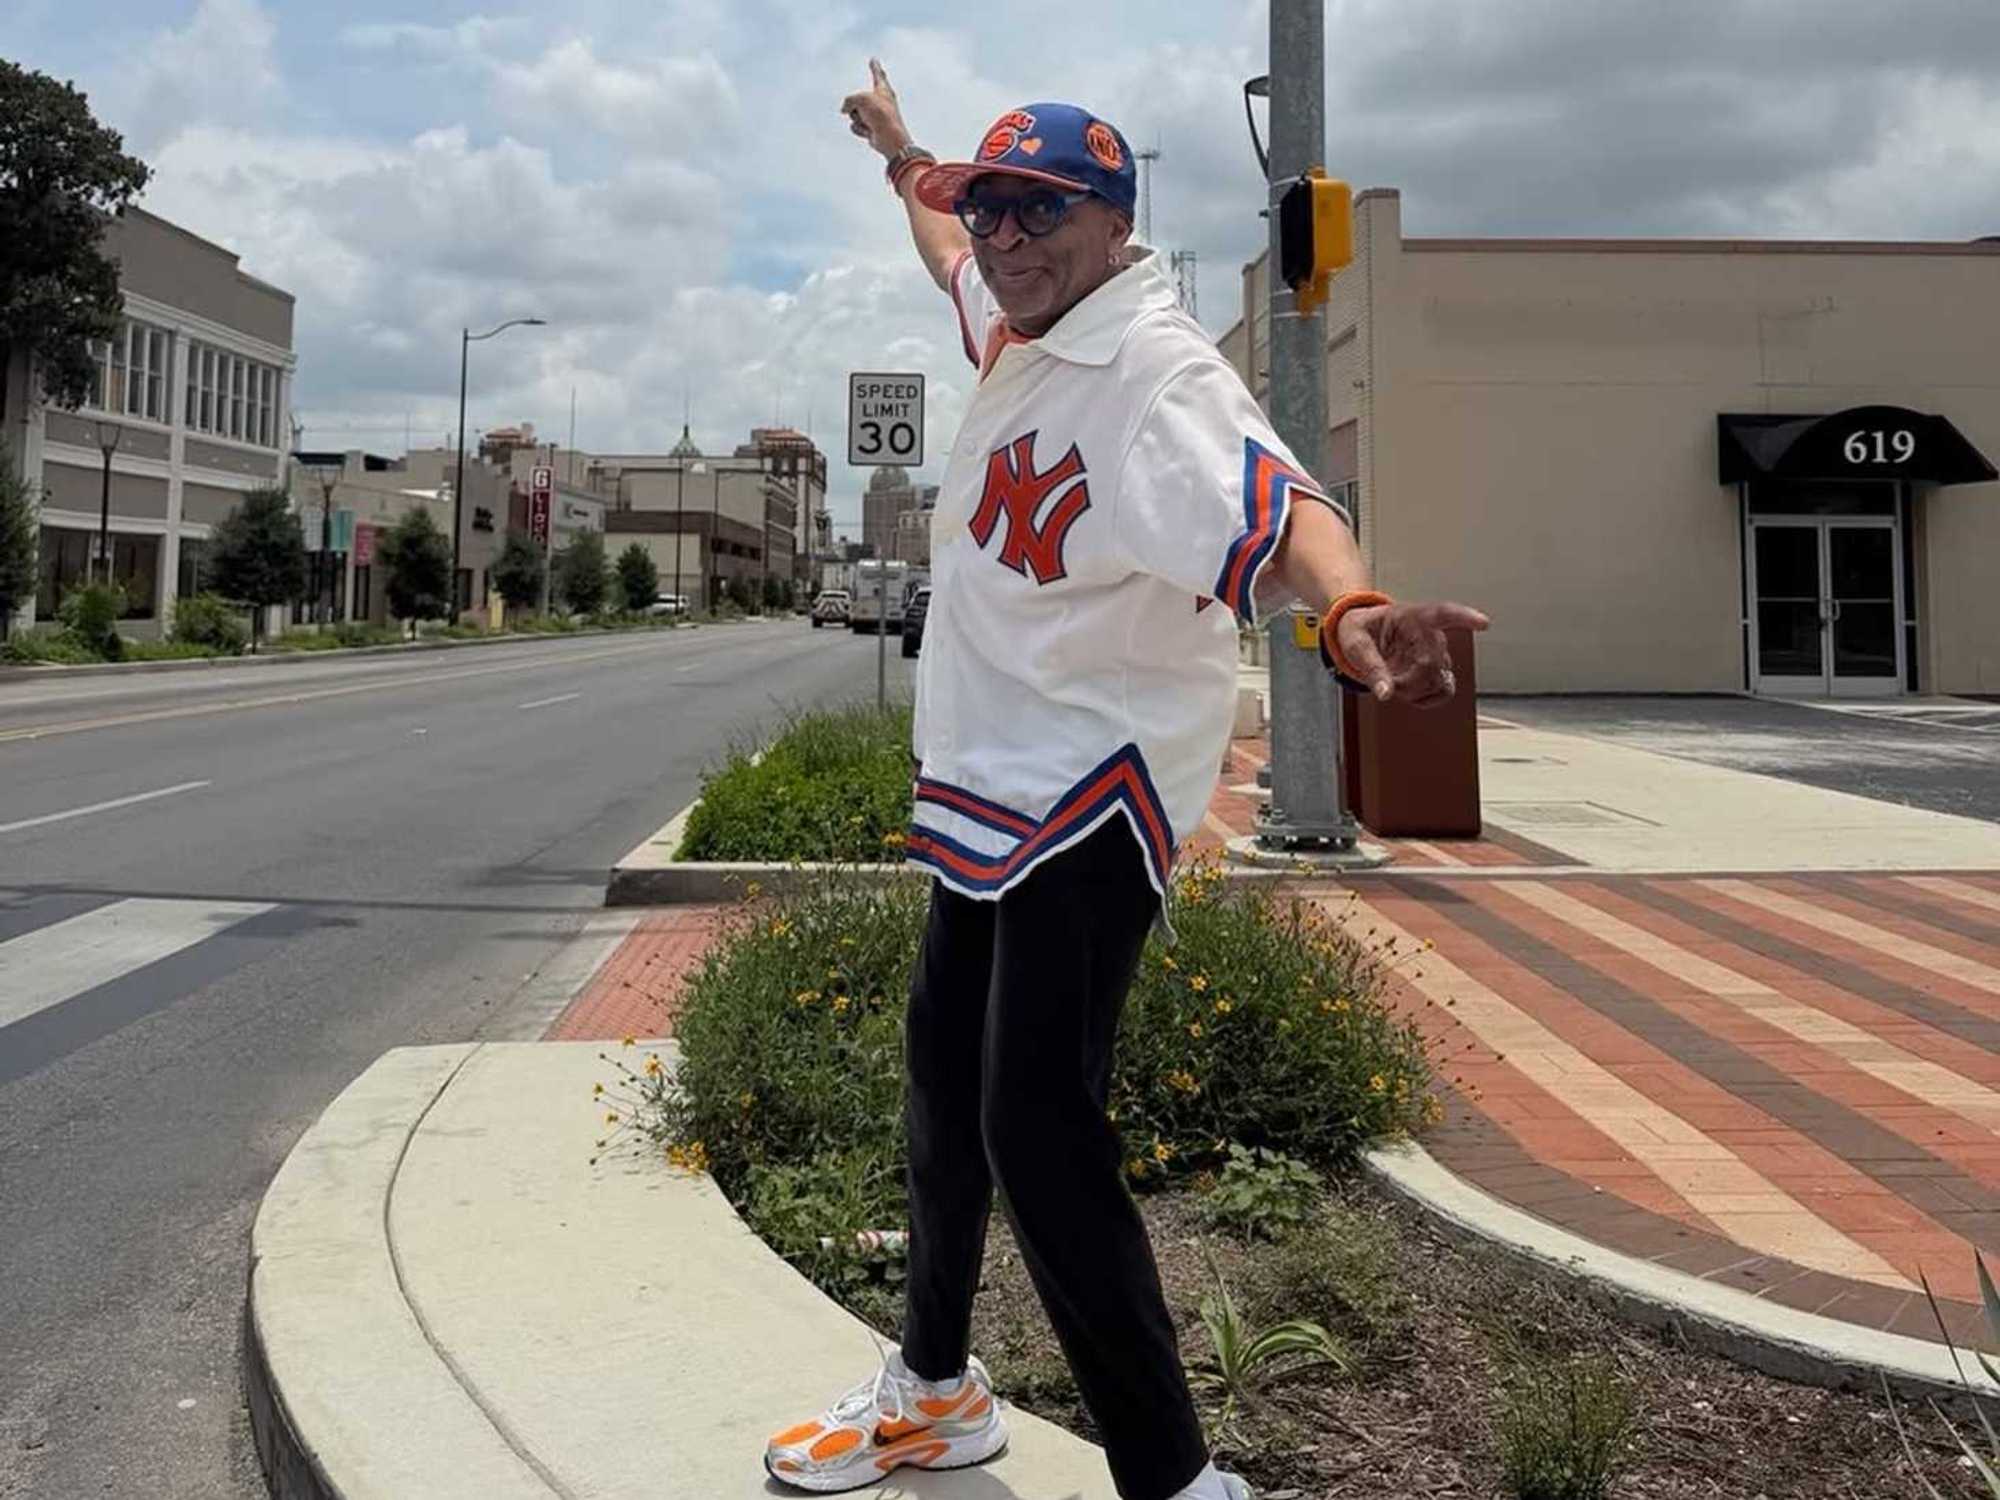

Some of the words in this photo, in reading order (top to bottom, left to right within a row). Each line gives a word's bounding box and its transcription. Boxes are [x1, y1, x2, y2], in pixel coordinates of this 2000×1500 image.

[856, 384, 918, 399] SPEED
[862, 403, 910, 418] LIMIT
[857, 421, 916, 455] 30
[1844, 430, 1915, 463] 619
[534, 470, 549, 488] G
